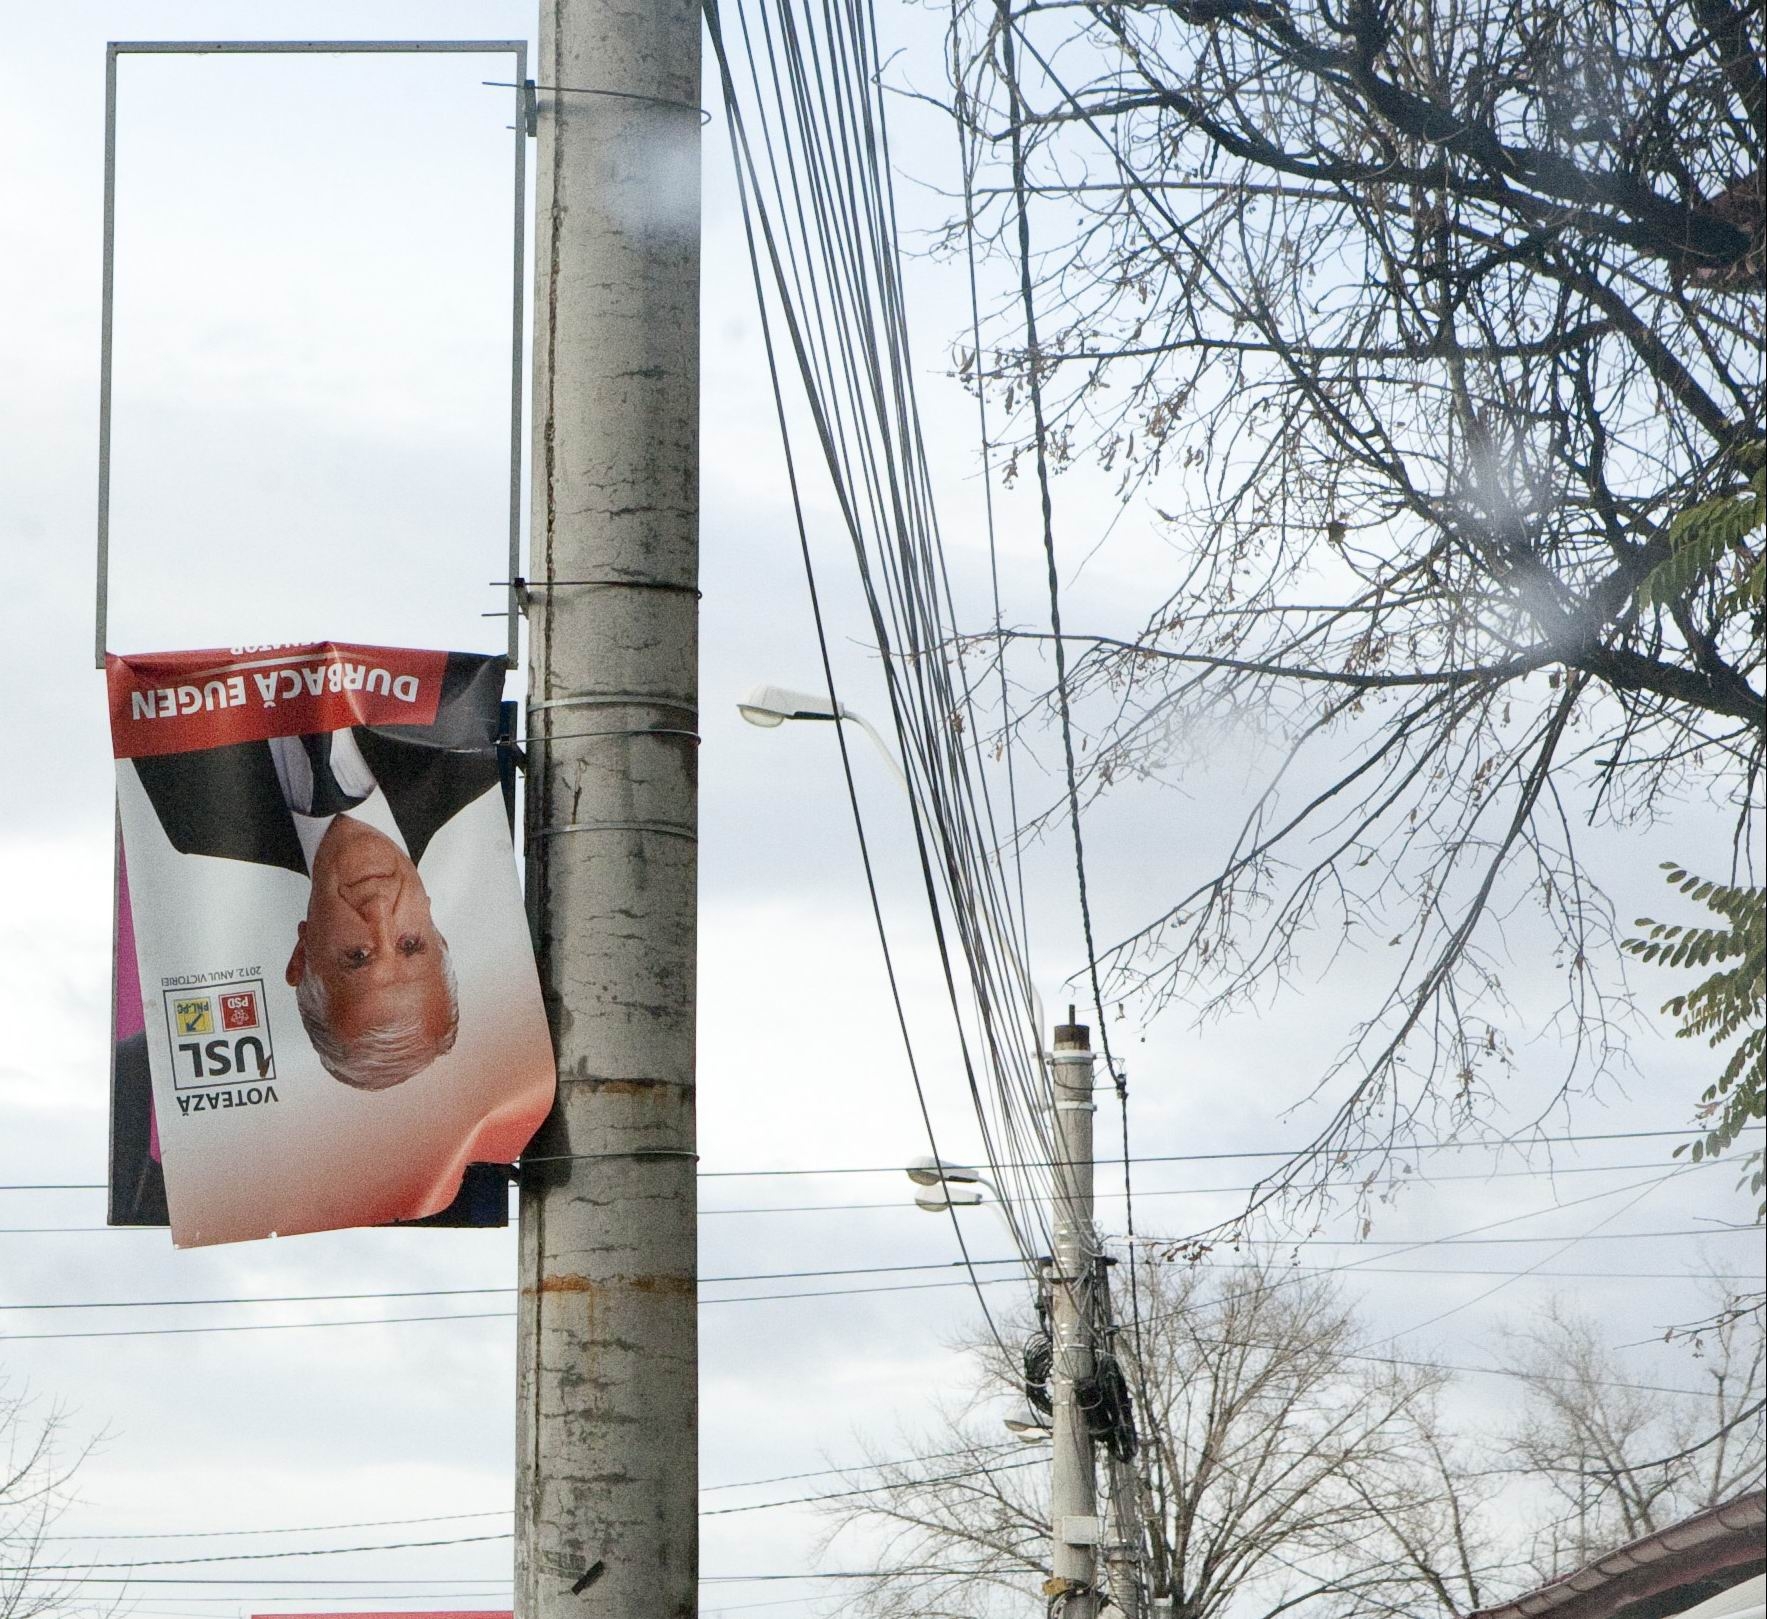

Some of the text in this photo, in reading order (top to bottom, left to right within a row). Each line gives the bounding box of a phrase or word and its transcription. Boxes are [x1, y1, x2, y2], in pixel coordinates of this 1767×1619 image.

[131, 661, 419, 720] DURBACĂ EUGEN
[161, 977, 207, 987] VICTORIEI
[210, 970, 234, 981] ANUL
[228, 997, 249, 1008] PSD
[178, 1036, 266, 1079] USL
[177, 1086, 279, 1117] VOTEAZĂ
